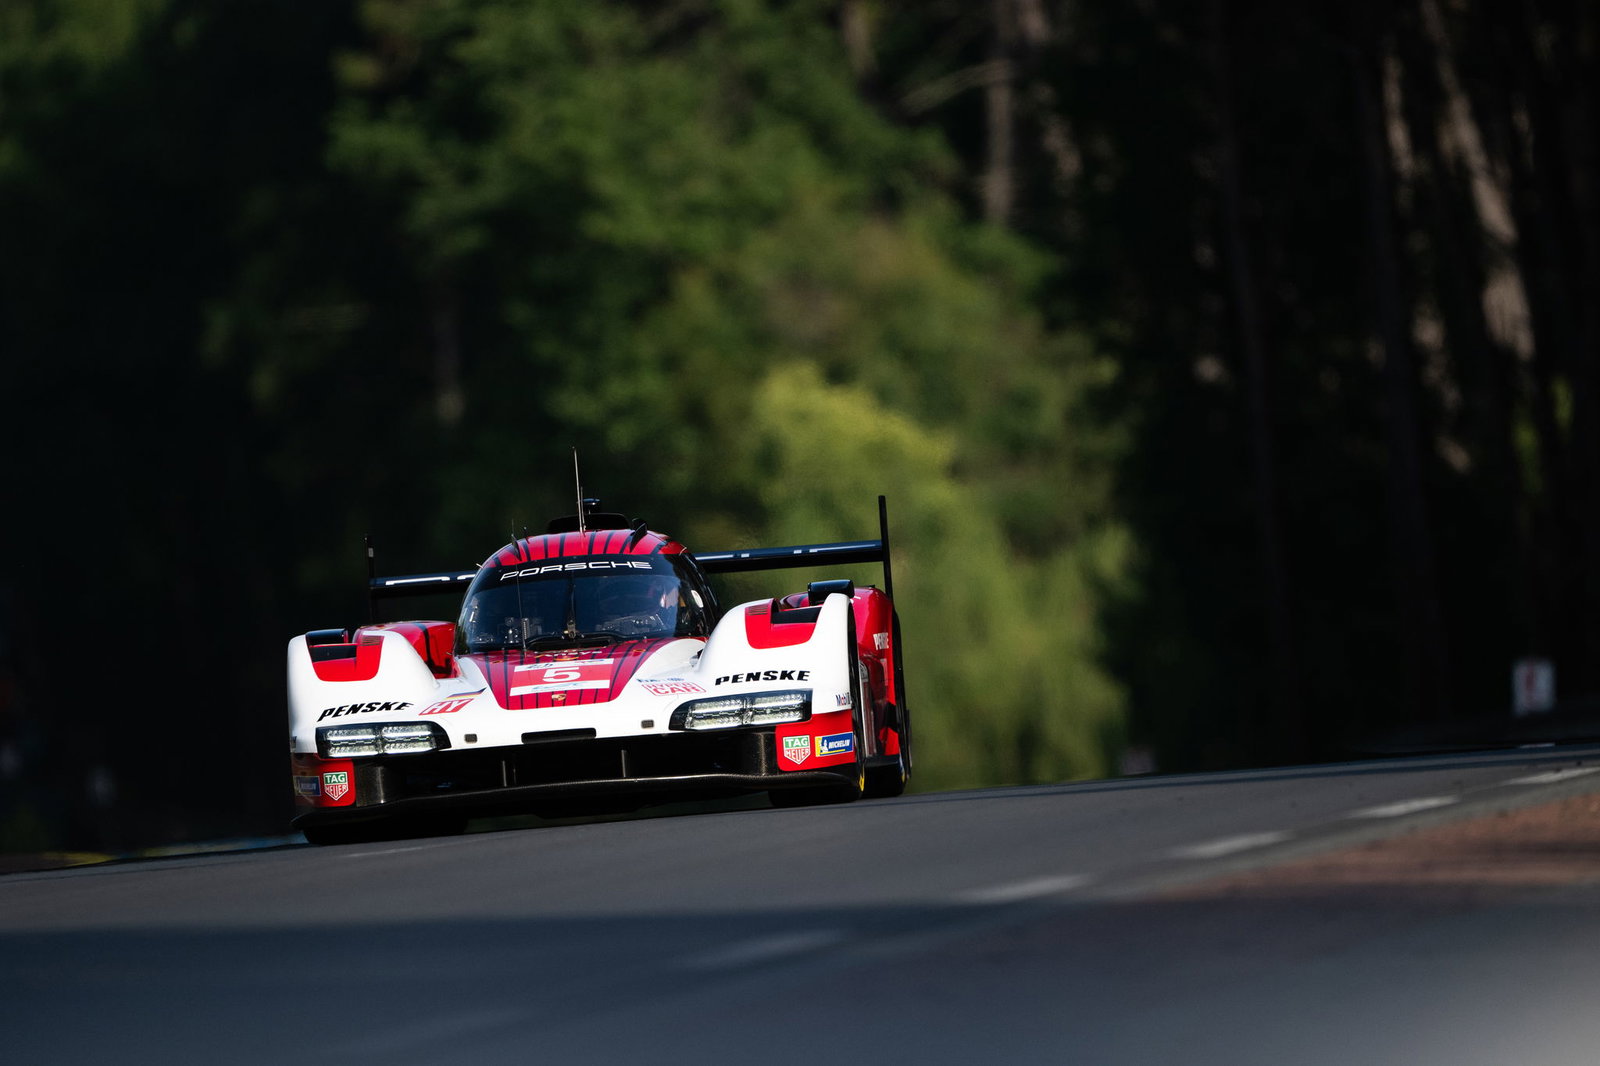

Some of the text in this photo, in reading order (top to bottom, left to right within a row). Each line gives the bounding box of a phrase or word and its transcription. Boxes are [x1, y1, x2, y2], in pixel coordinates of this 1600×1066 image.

[500, 561, 652, 581] PORSCHE
[542, 667, 581, 682] 5
[715, 670, 810, 685] PENSKE
[317, 702, 414, 722] PENSKE
[785, 738, 808, 747] TAG
[828, 739, 851, 749] MICHELIN
[785, 748, 809, 762] HEUER
[325, 775, 345, 783] TAG
[325, 784, 347, 798] HEUER
